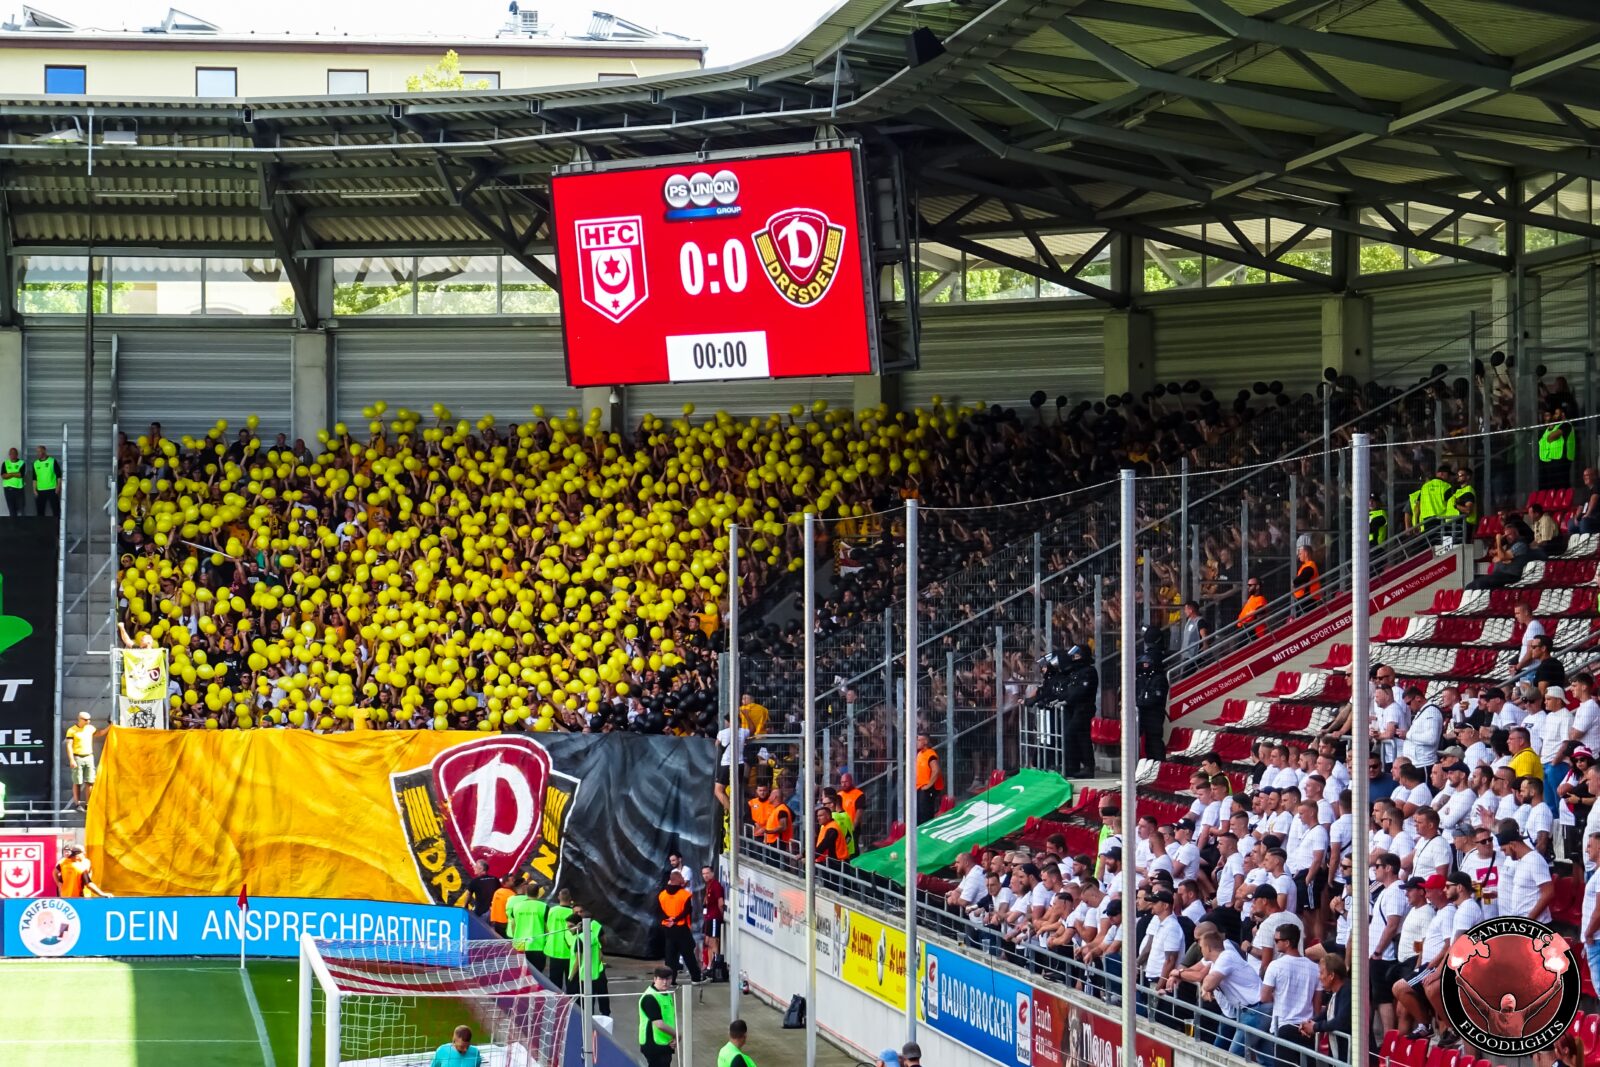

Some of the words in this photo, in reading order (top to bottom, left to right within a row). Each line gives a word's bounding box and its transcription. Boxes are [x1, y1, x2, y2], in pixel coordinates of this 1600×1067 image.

[669, 184, 688, 198] PS
[691, 180, 735, 196] UNION
[716, 206, 742, 215] GROUP
[583, 224, 635, 247] HFC
[680, 238, 748, 296] 0:0
[767, 256, 837, 304] DRESDEN
[693, 340, 747, 370] 00:00
[1271, 643, 1300, 662] MITTEN
[1299, 638, 1311, 648] IM
[0, 847, 37, 859] HFC
[21, 899, 76, 931] TARIFEGURU
[105, 910, 178, 941] DEIN
[201, 909, 451, 953] ANSPRECHPARTNER
[941, 972, 968, 1023] RADIO
[969, 985, 1013, 1046] BROCKEN
[1033, 999, 1052, 1033] Tauch
